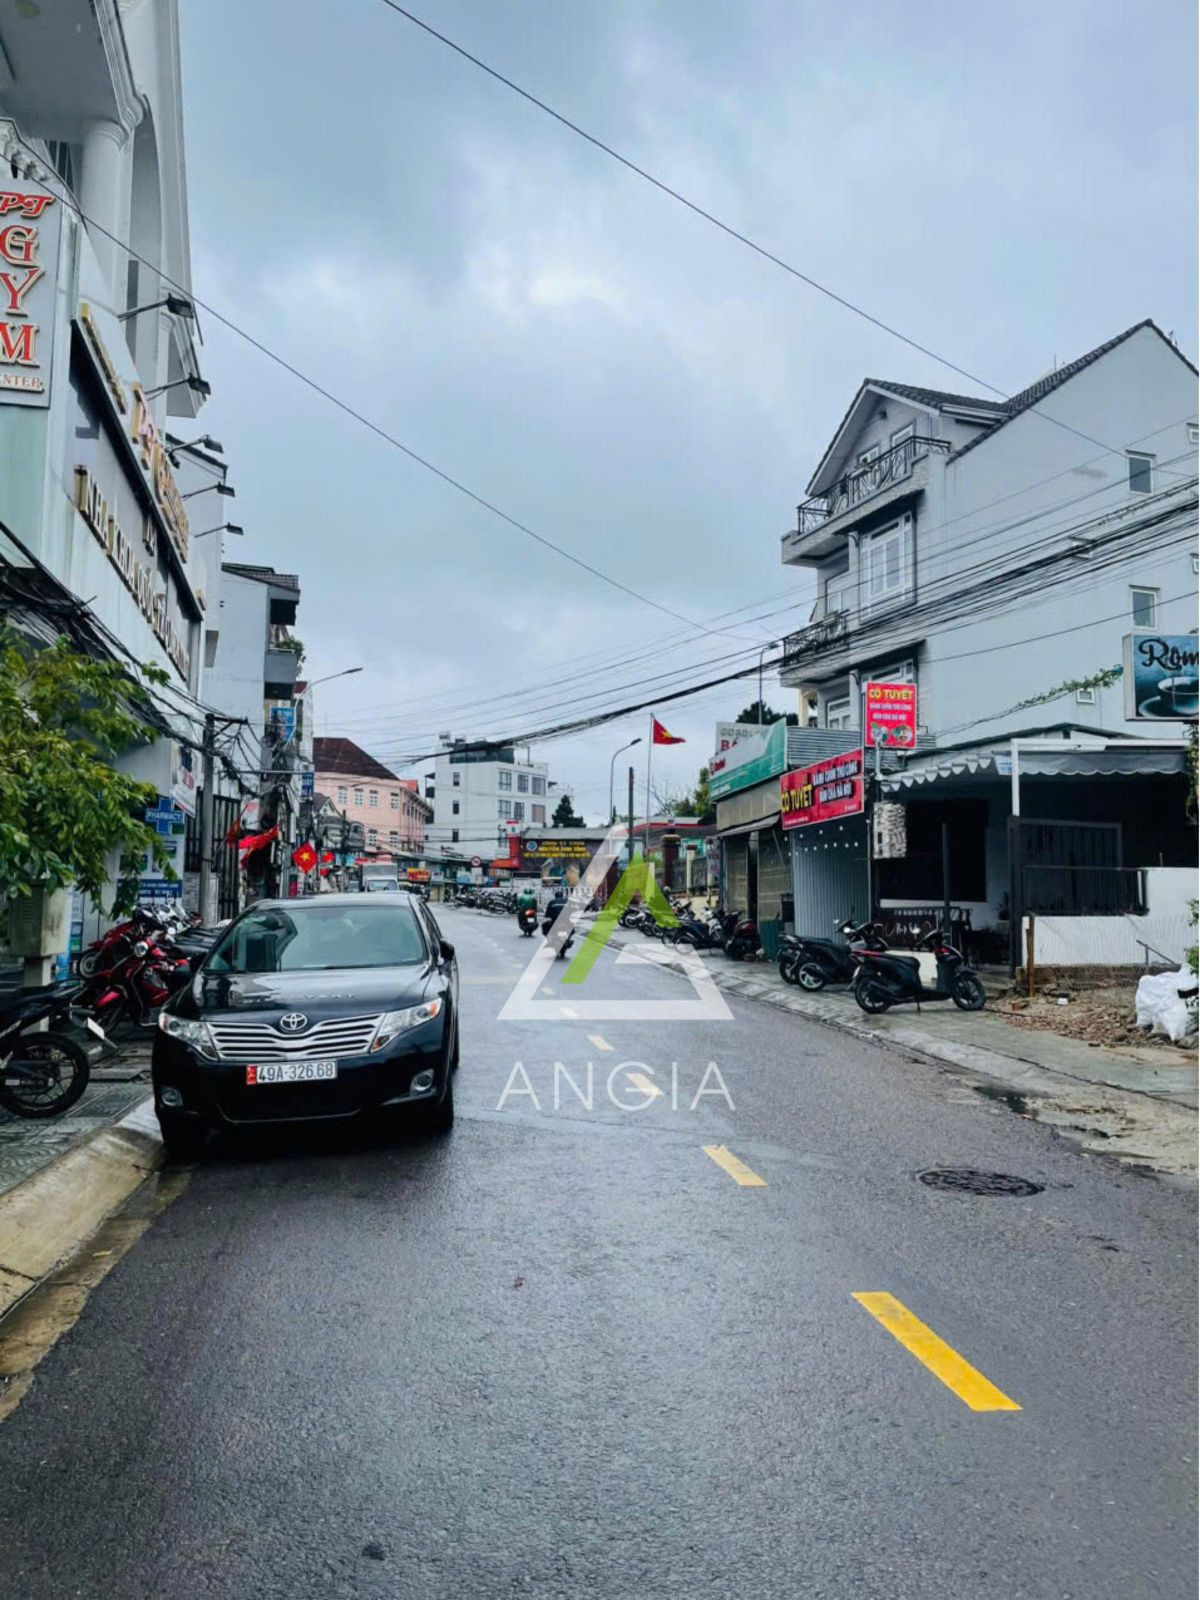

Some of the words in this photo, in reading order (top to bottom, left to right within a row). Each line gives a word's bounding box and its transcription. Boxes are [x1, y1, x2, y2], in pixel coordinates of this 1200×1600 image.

[0, 224, 45, 368] GYM
[0, 373, 43, 391] NTER
[146, 809, 182, 821] PHARMACY
[258, 1062, 334, 1082] 49A-326.68
